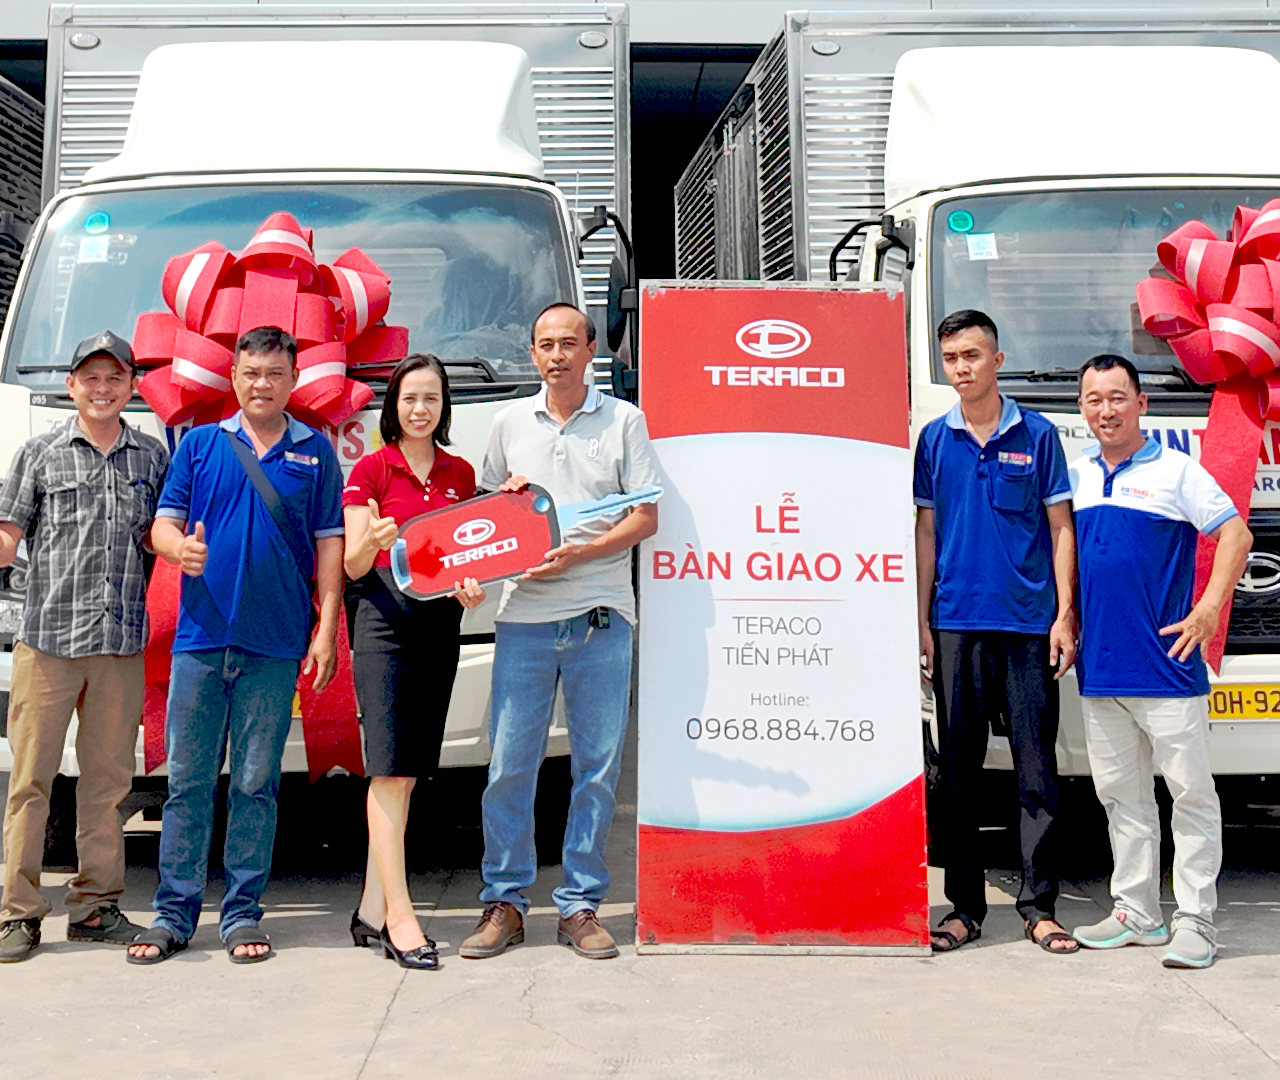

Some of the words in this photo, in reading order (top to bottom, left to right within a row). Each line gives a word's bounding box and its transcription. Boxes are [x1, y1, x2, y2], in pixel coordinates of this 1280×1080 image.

[704, 366, 845, 388] TERACO
[756, 492, 800, 534] LỄ
[439, 537, 518, 568] TERACO
[652, 543, 731, 580] BÀN
[746, 551, 842, 582] GIAO
[855, 553, 905, 583] XE
[732, 616, 822, 636] TERACO
[777, 643, 834, 666] PHÁT
[750, 693, 810, 707] Hotline:
[686, 717, 875, 742] 0968.884.768
